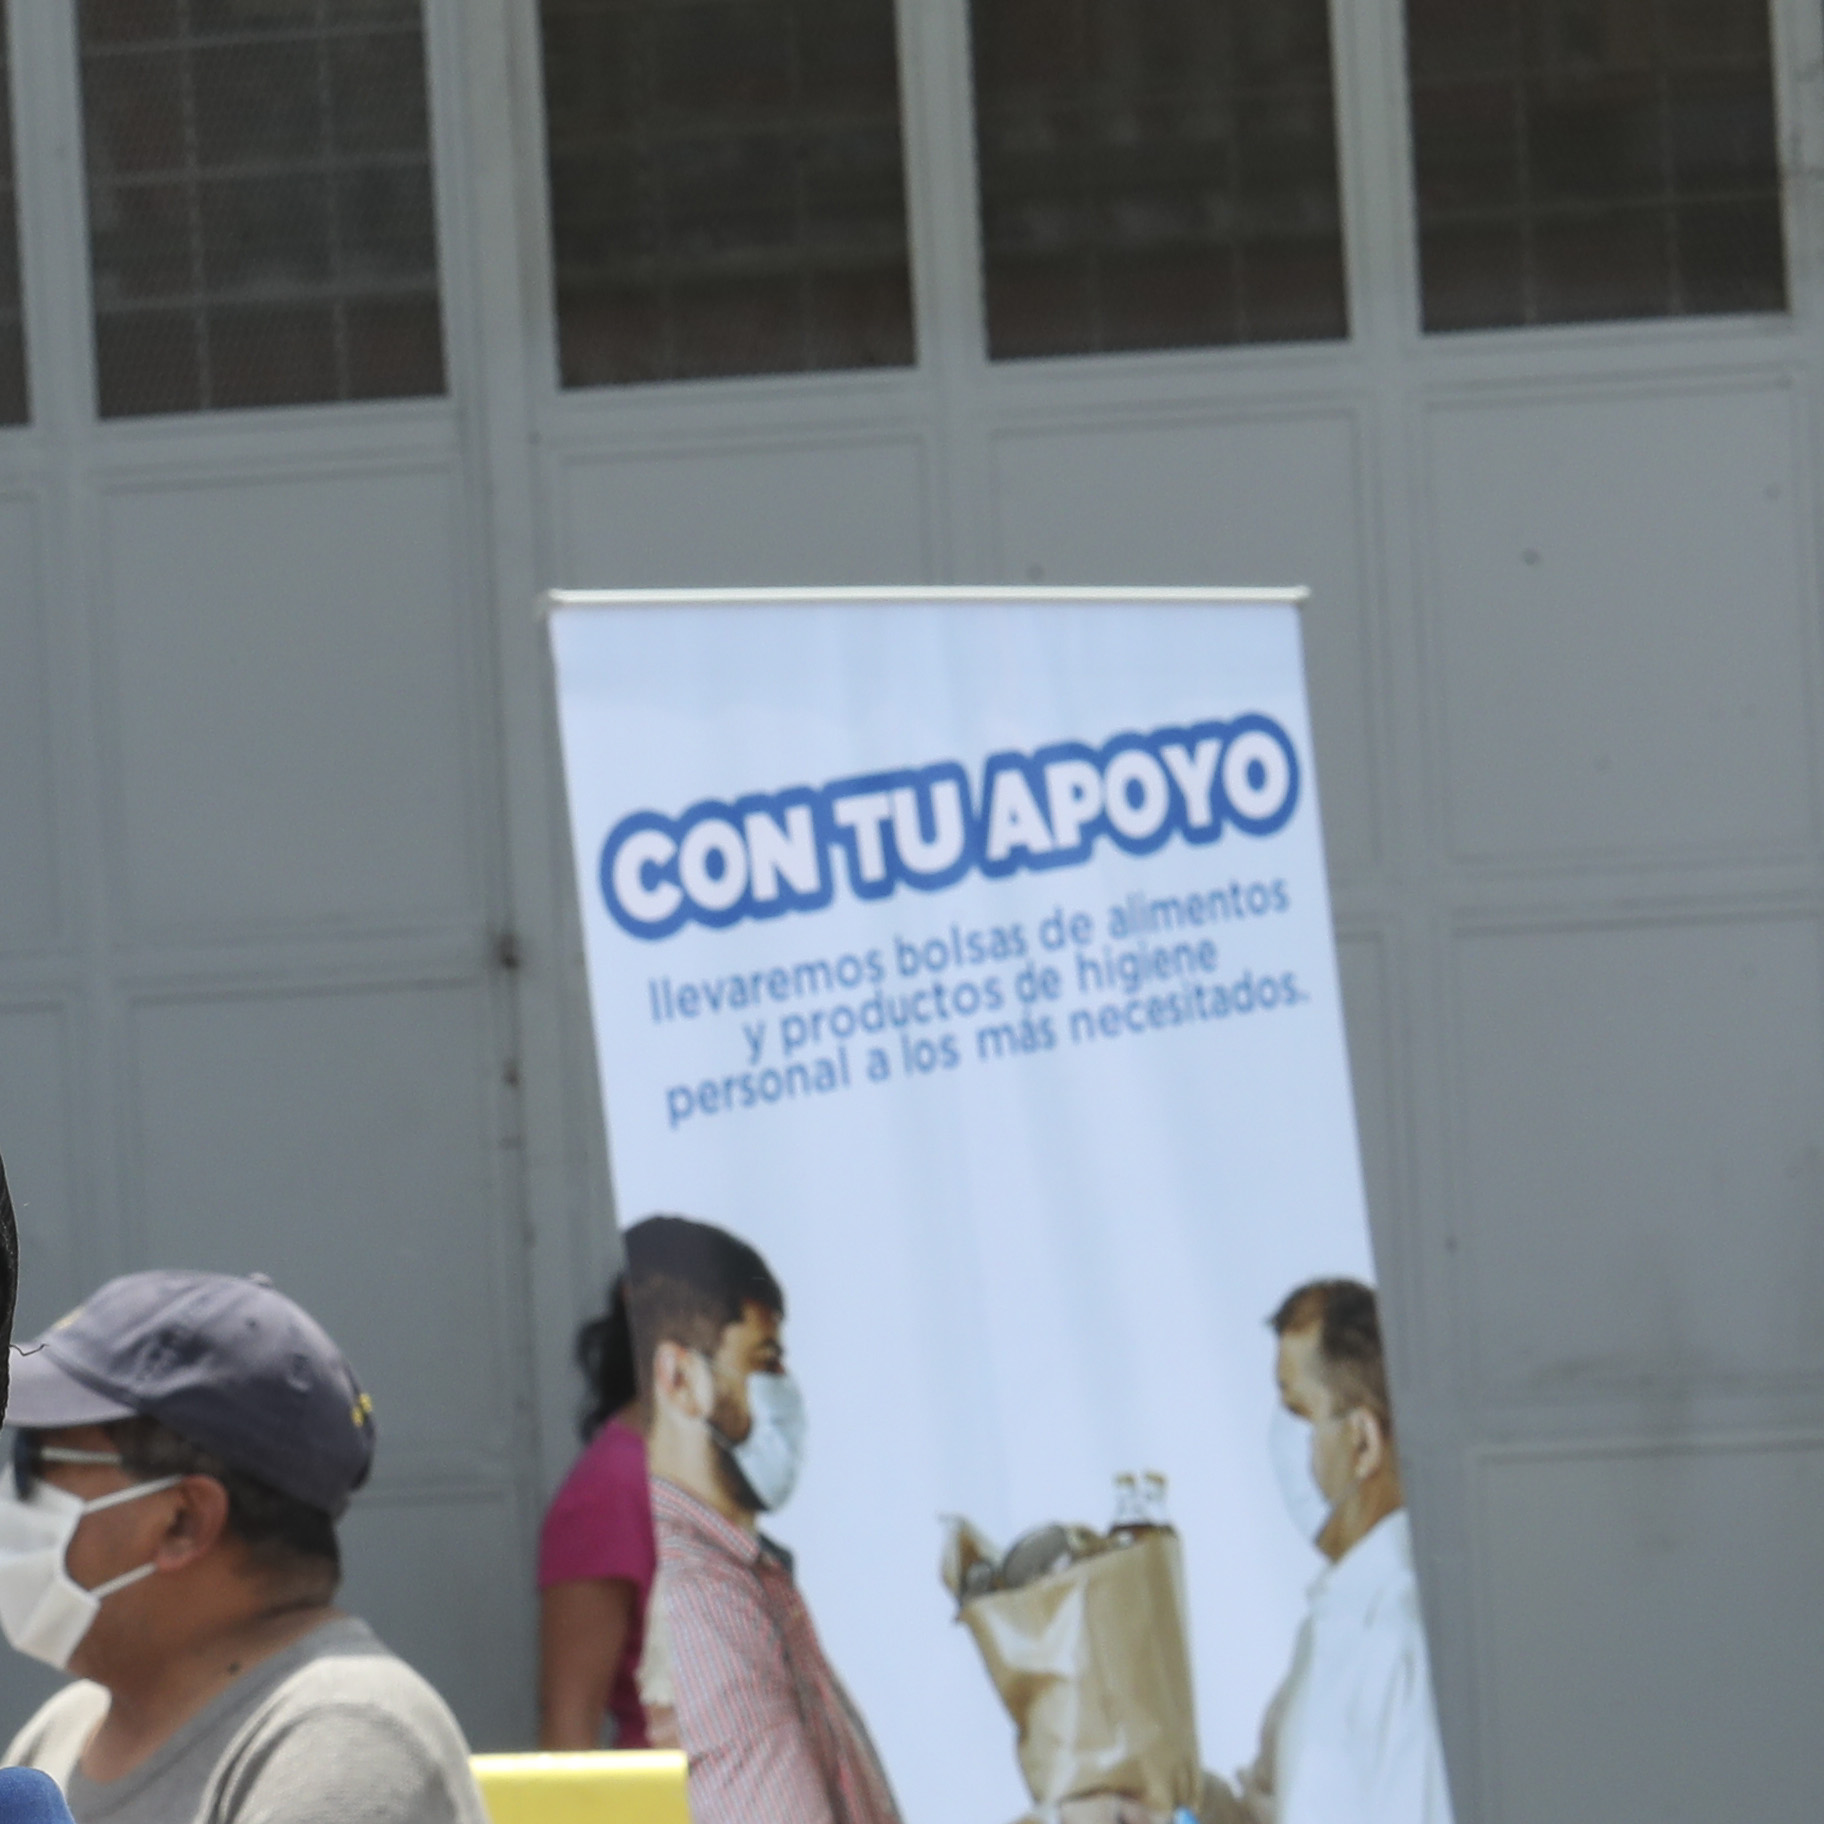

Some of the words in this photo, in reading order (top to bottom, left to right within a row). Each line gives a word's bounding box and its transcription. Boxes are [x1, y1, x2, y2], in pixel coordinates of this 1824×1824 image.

[609, 800, 825, 926] CON
[832, 778, 966, 885] TU
[984, 728, 1293, 864] APOYO
[648, 948, 887, 1024] llevaremos
[894, 923, 1029, 979] bolsas
[1038, 906, 1095, 952] de
[1108, 878, 1290, 940] alimentos
[743, 1020, 766, 1064] y
[780, 975, 1004, 1057] productos
[1014, 960, 1062, 1005] de
[1074, 938, 1219, 996] higiene
[665, 1044, 851, 1129] personal
[866, 1046, 890, 1083] a
[901, 1032, 961, 1076] los
[976, 1004, 1058, 1063] más
[1067, 968, 1312, 1045] necesitados.
